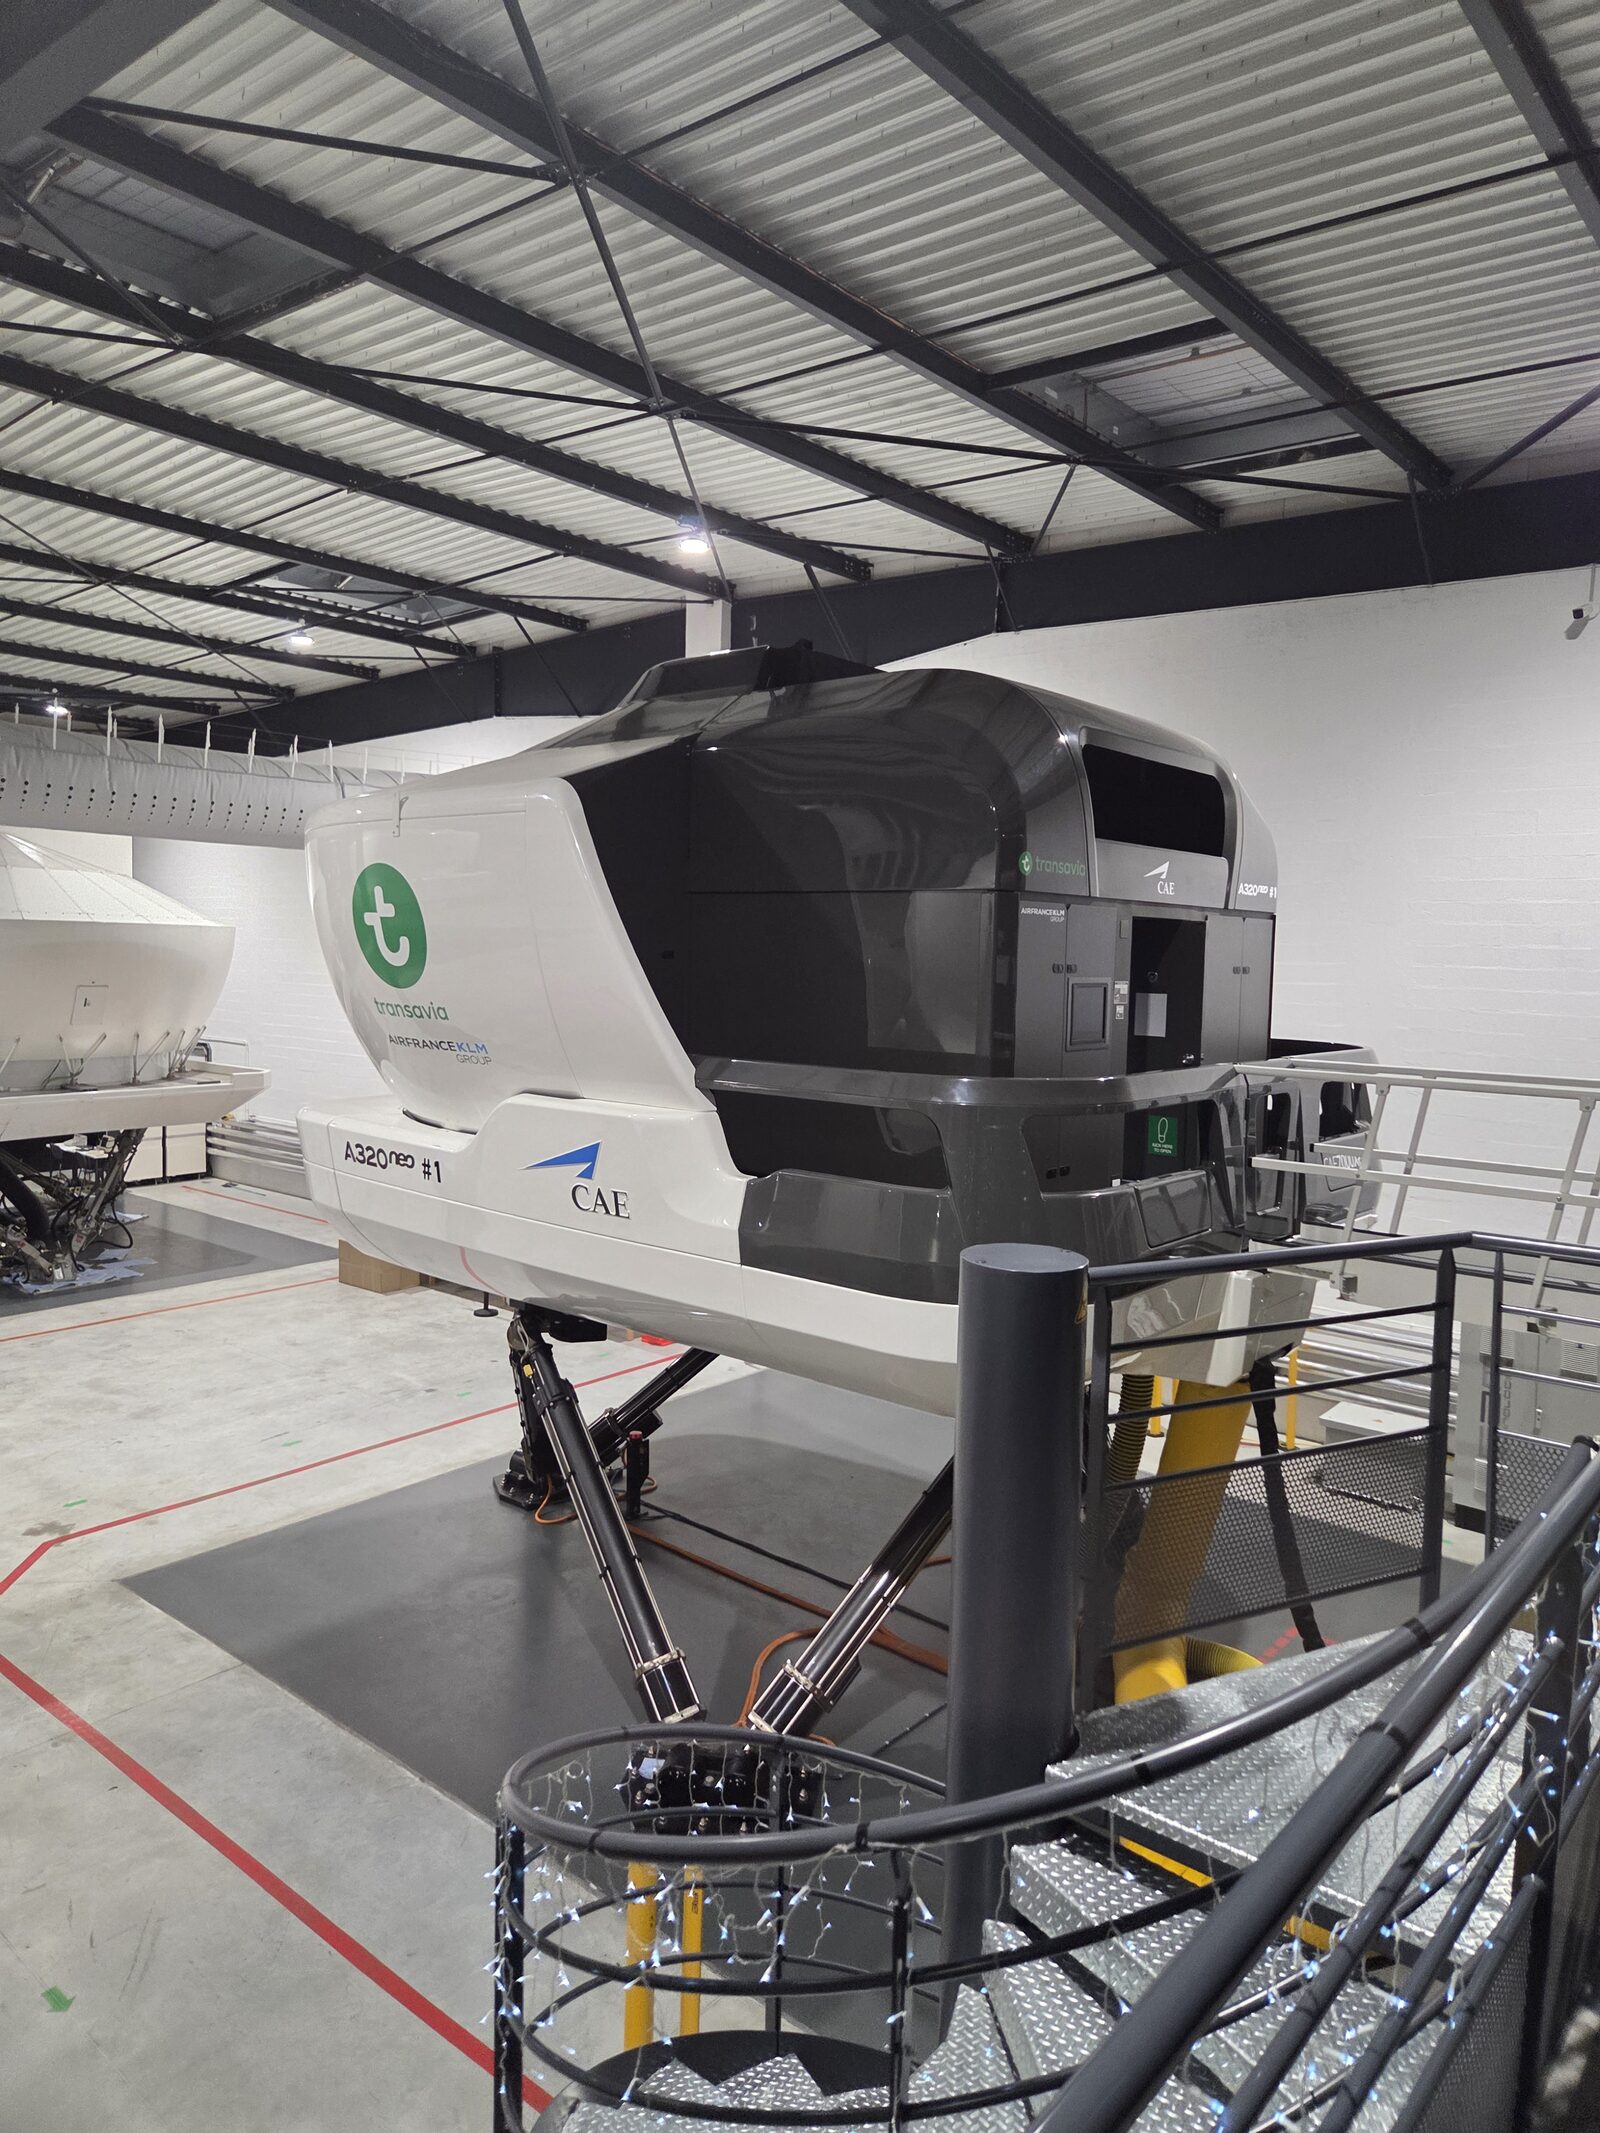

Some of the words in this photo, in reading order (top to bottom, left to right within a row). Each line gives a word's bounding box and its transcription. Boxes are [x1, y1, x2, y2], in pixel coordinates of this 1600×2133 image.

[1035, 856, 1086, 876] transavia
[1157, 881, 1175, 895] CAE
[373, 997, 449, 1021] transavia
[455, 1053, 492, 1066] GROUP
[344, 1141, 415, 1170] A320neo
[421, 1158, 441, 1183] #1
[571, 1184, 631, 1219] CAE
